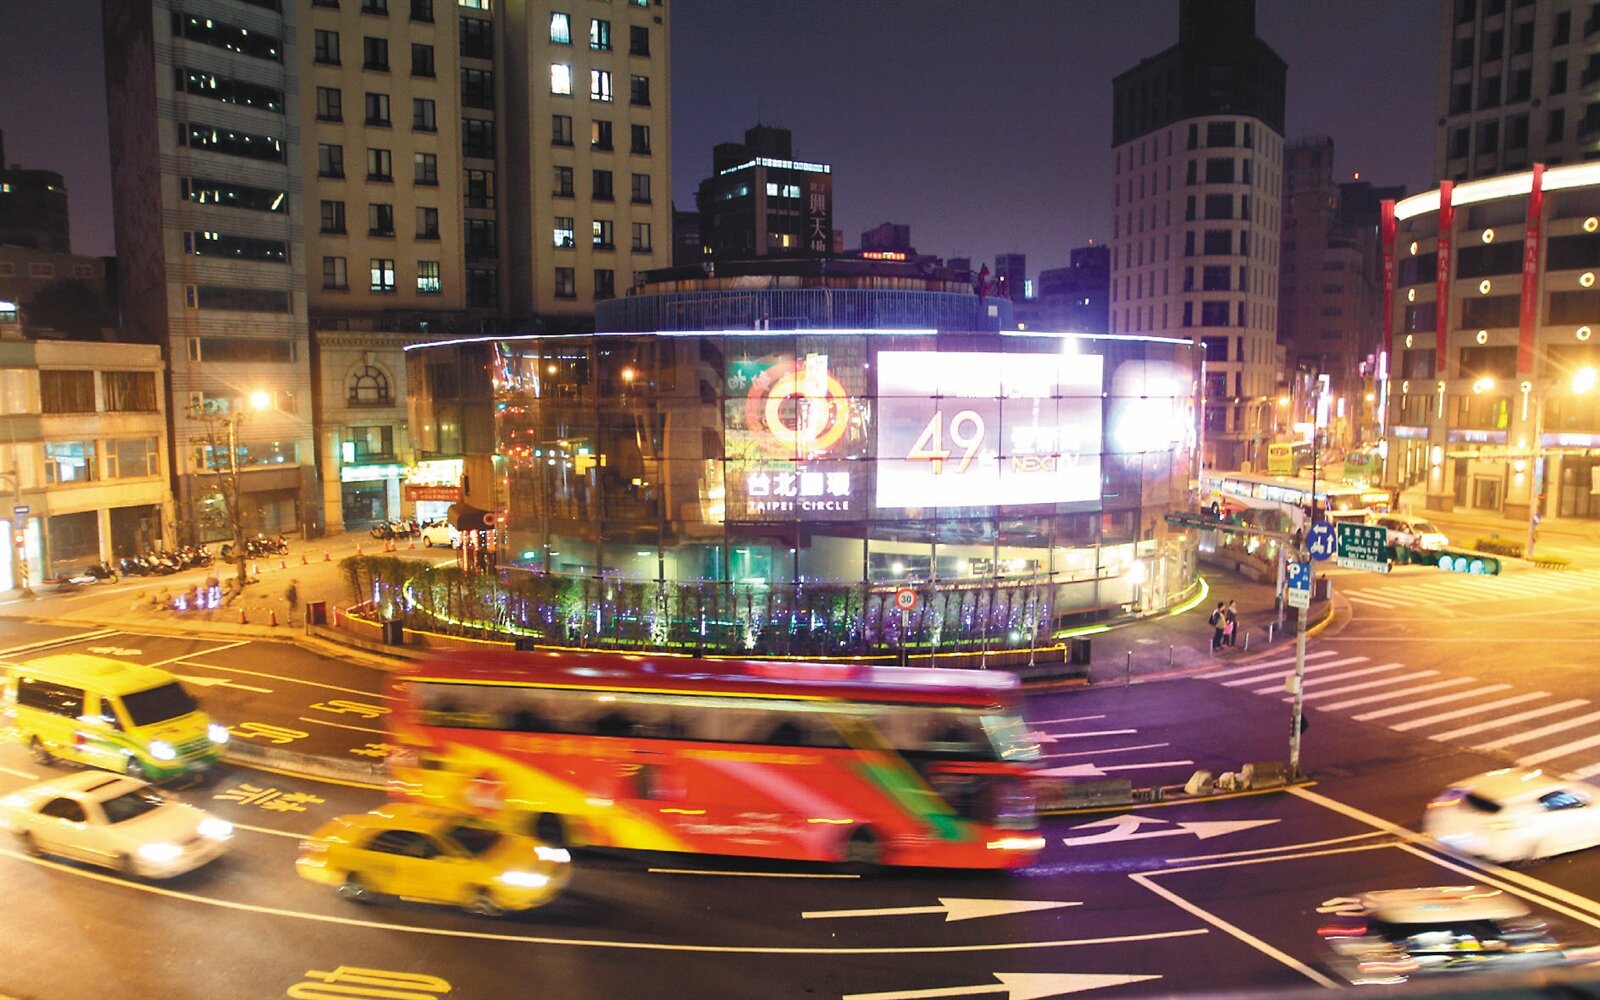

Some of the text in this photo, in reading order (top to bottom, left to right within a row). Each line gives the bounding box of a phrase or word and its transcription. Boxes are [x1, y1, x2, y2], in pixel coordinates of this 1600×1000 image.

[907, 410, 985, 475] 49
[749, 500, 849, 511] TAIPEI CIRCLE
[1289, 563, 1301, 580] P
[901, 594, 912, 603] 30
